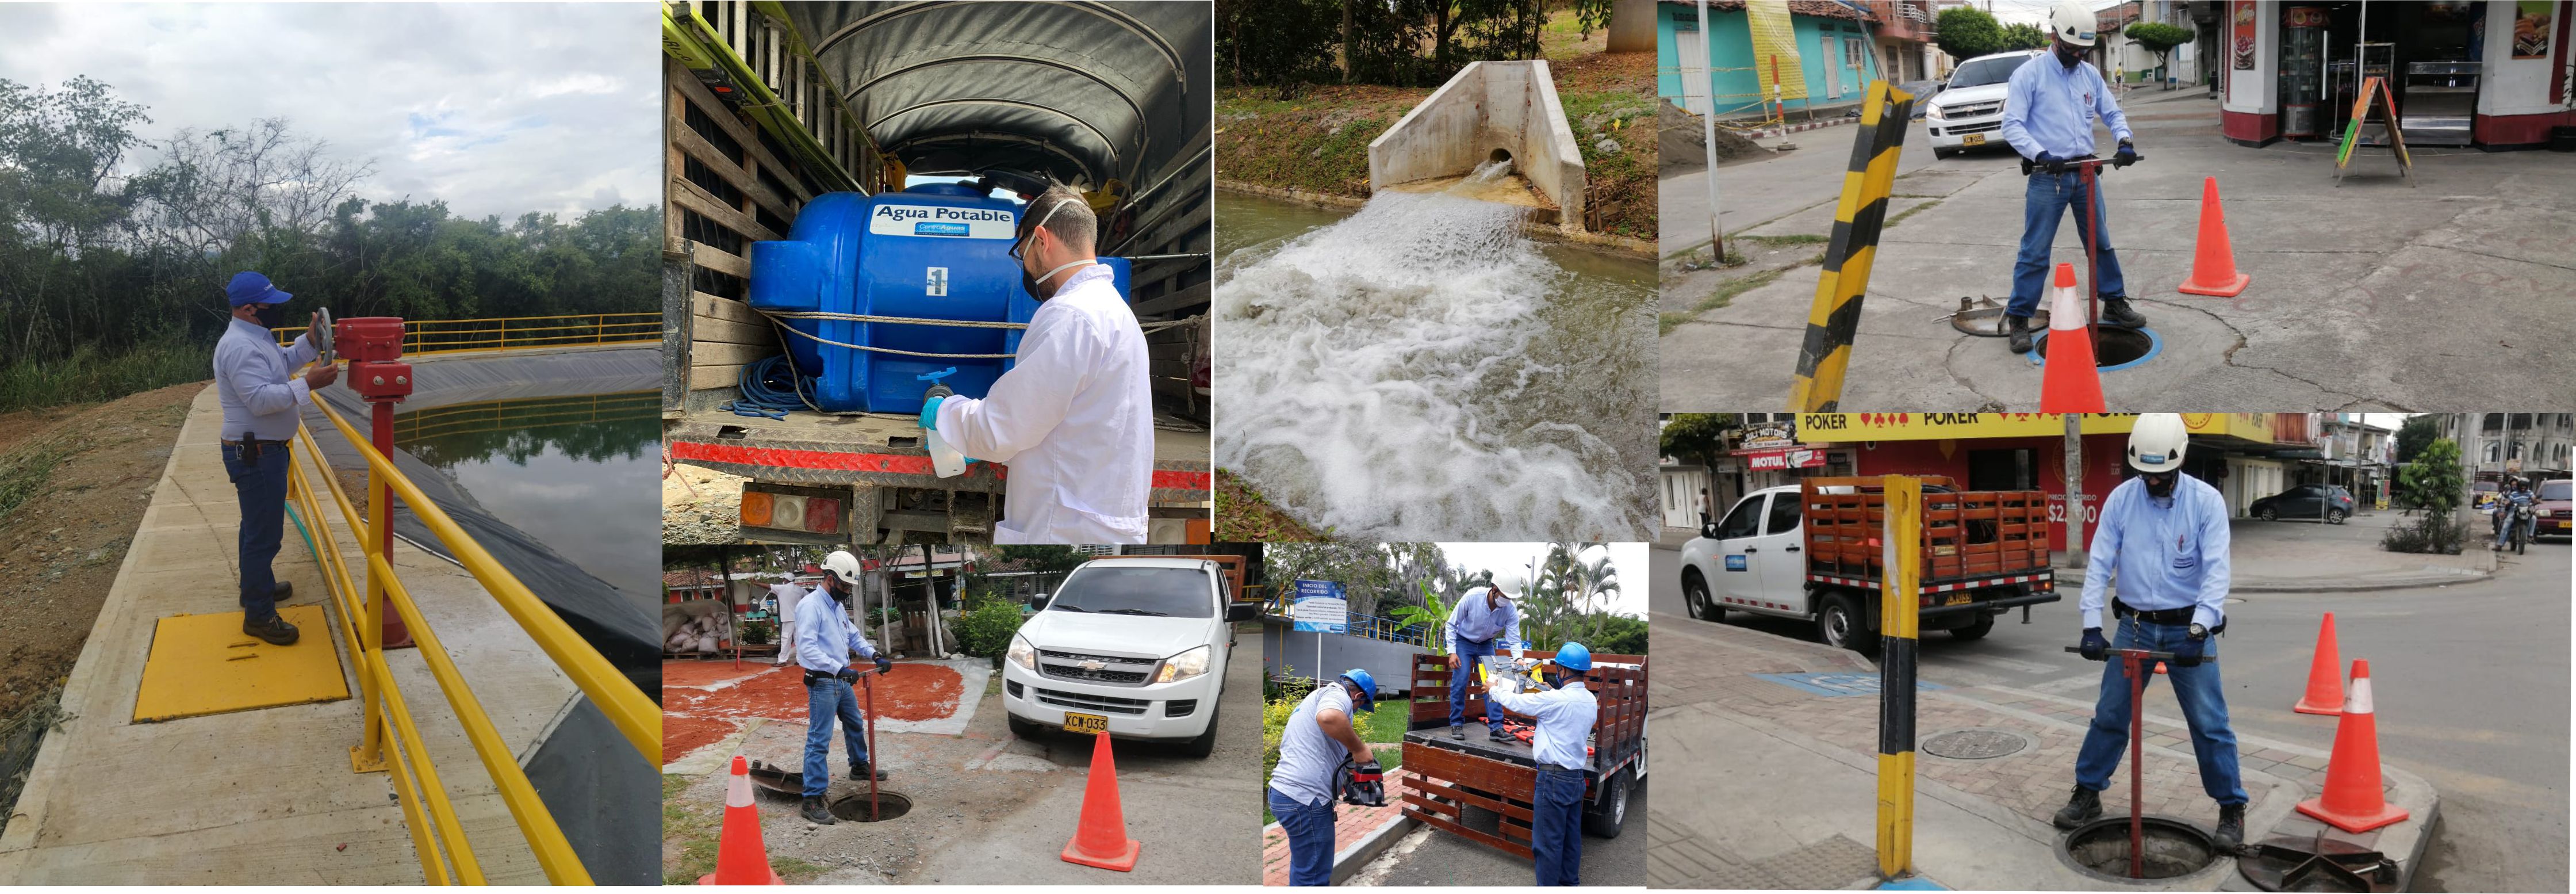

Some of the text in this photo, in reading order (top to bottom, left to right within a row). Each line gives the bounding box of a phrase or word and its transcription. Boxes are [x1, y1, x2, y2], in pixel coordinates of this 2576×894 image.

[876, 206, 1010, 222] Agua Potable
[931, 269, 942, 295] 1
[1805, 414, 1847, 430] POKER
[1759, 427, 1788, 439] MOTORS
[1751, 456, 1785, 468] MOTUL
